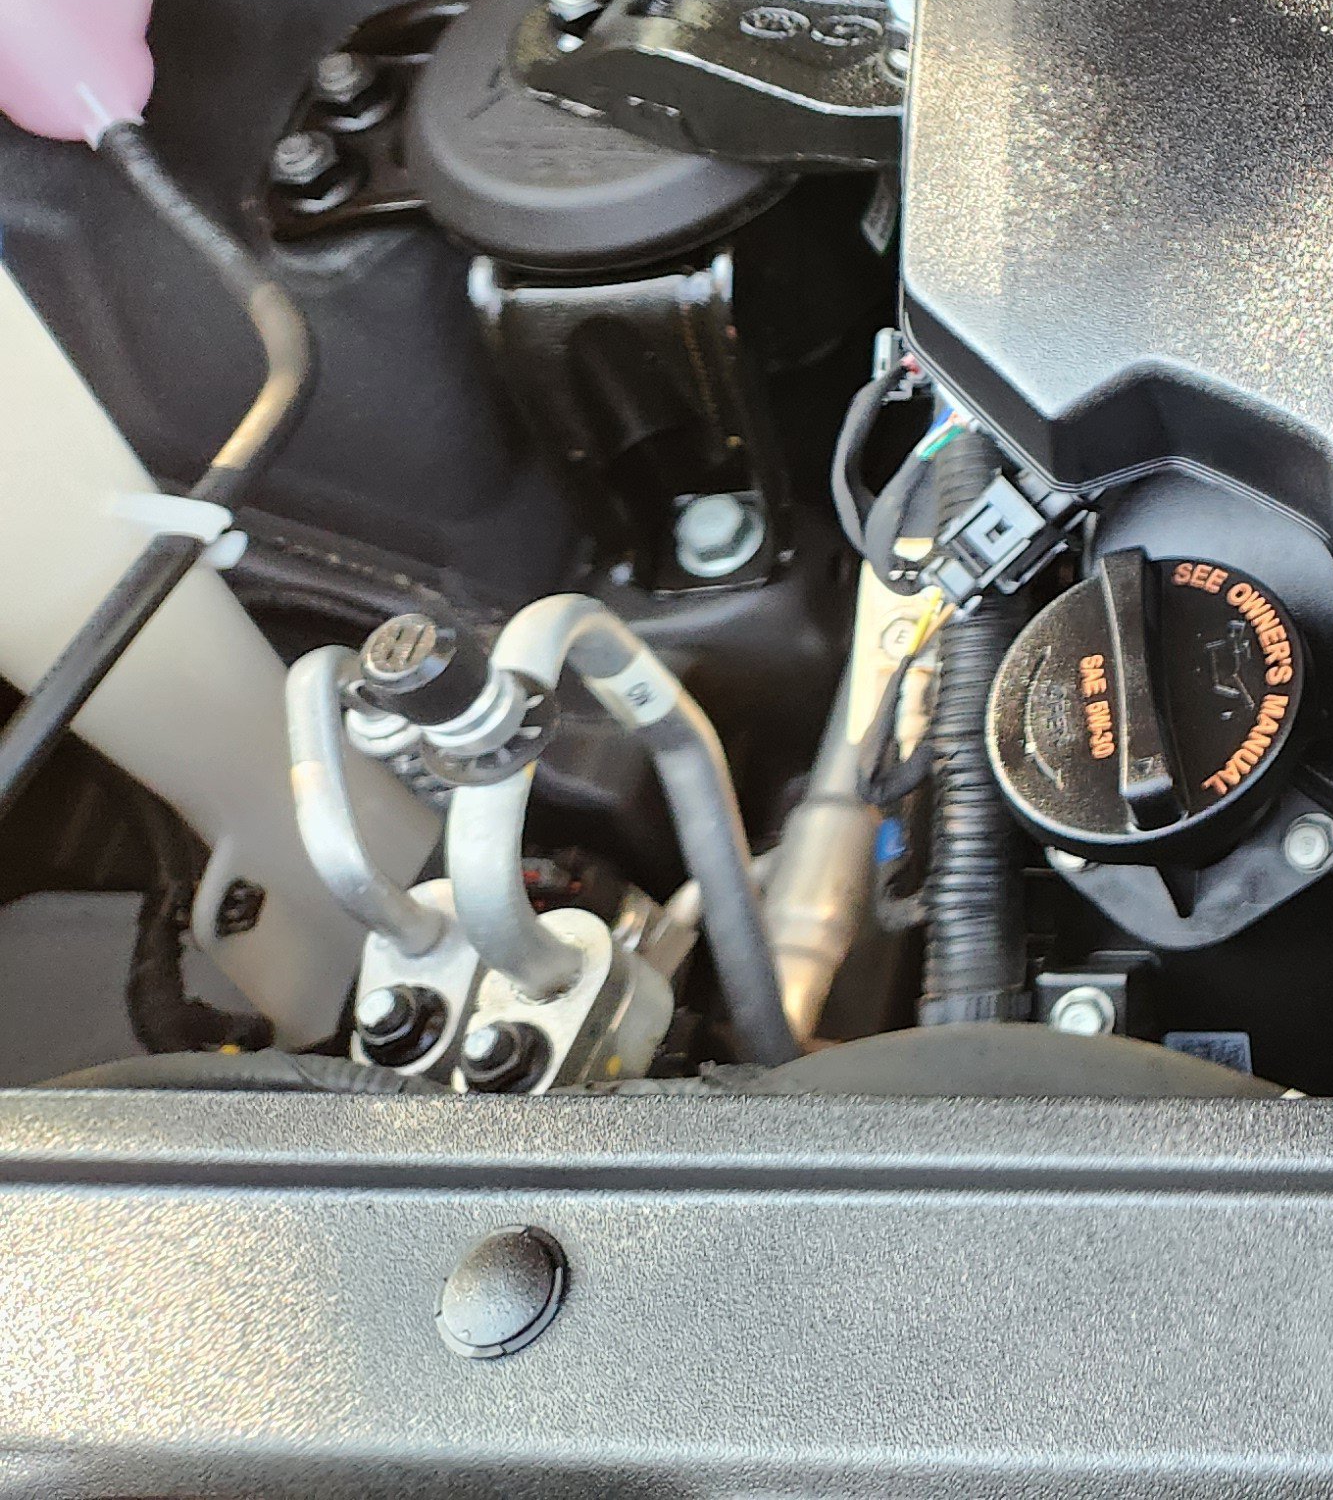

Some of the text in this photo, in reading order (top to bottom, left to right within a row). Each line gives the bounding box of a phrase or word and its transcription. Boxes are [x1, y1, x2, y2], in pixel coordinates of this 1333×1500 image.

[1079, 654, 1107, 698] SAE
[1172, 562, 1294, 796] SEE OWNER'S MANUAL
